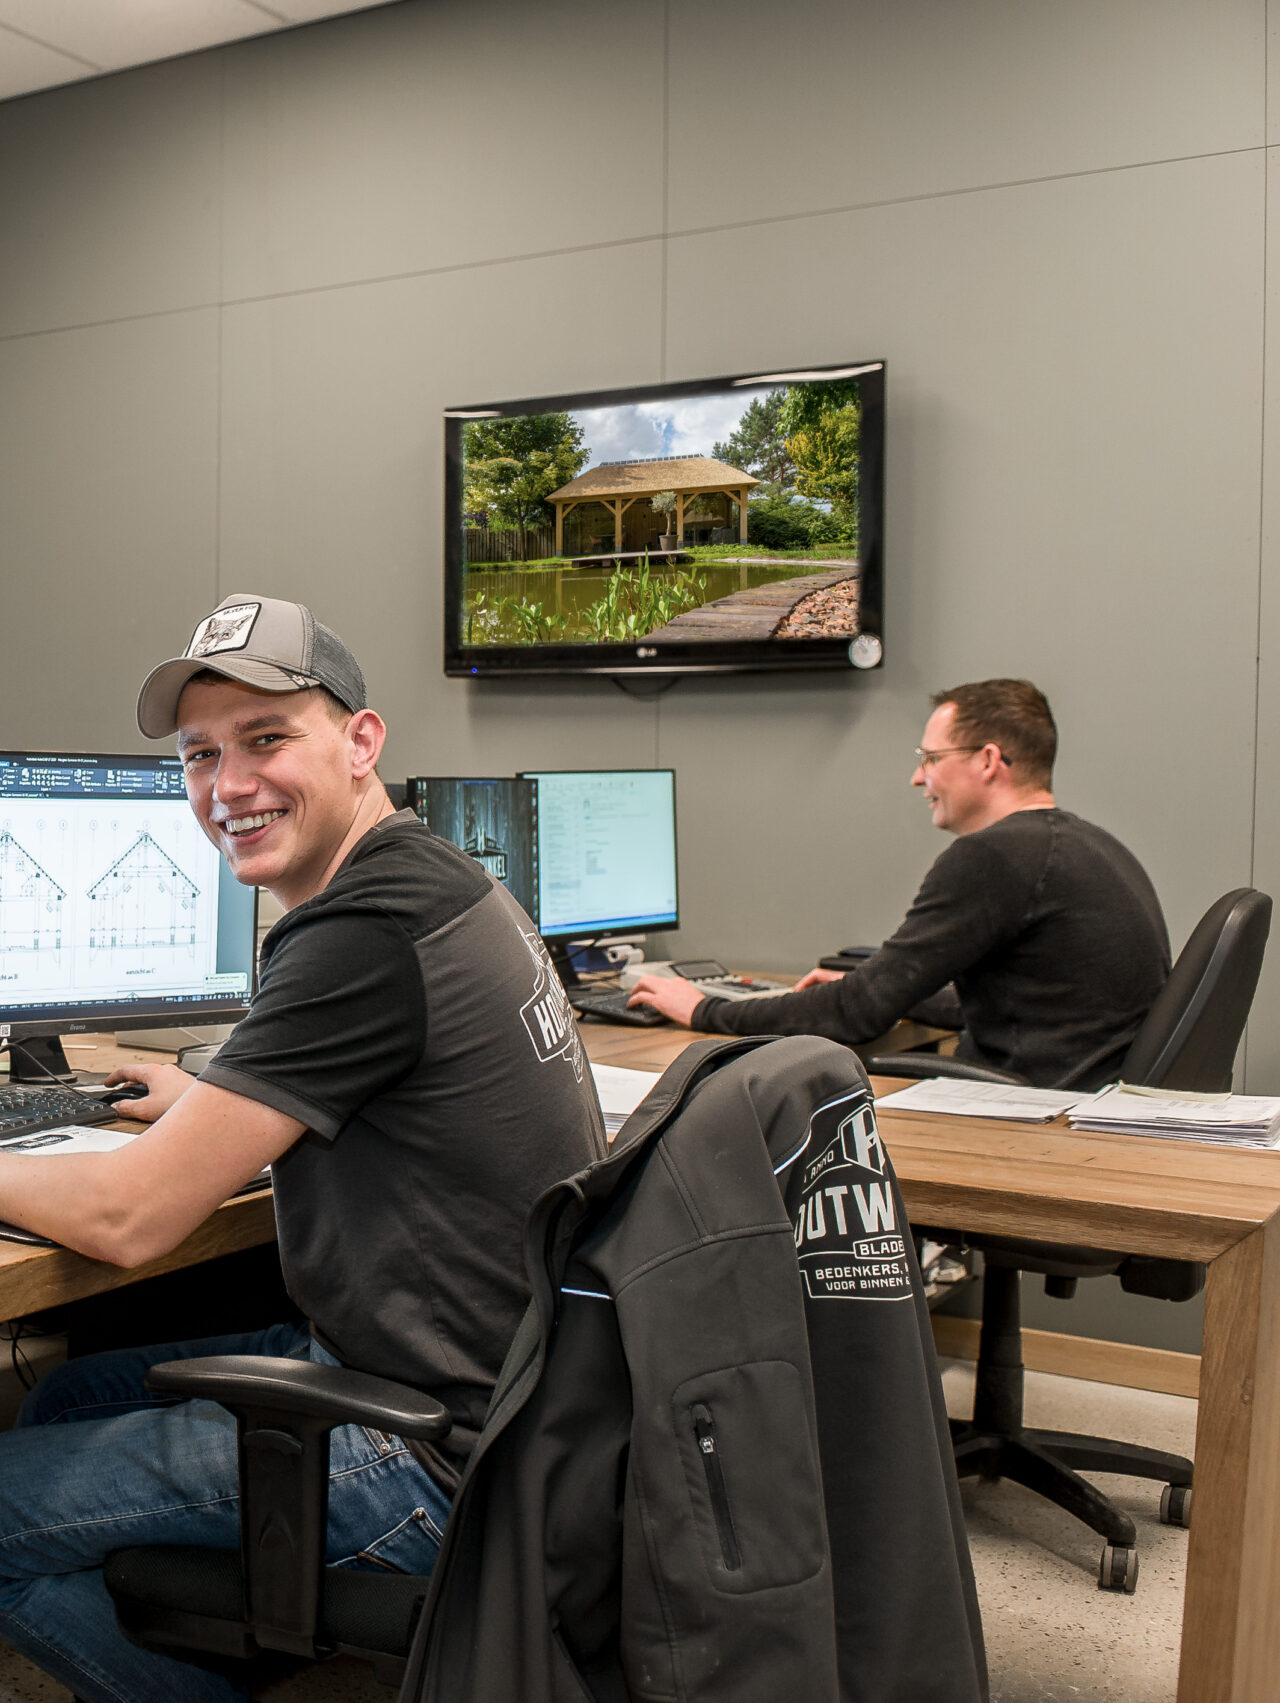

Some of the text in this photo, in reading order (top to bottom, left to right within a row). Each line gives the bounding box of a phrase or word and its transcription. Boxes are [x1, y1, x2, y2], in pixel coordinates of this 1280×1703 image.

[811, 1150, 834, 1180] ANNO
[815, 1262, 903, 1280] BEDENKERS,
[825, 1279, 856, 1291] VOOR
[860, 1277, 904, 1289] BINNEN
